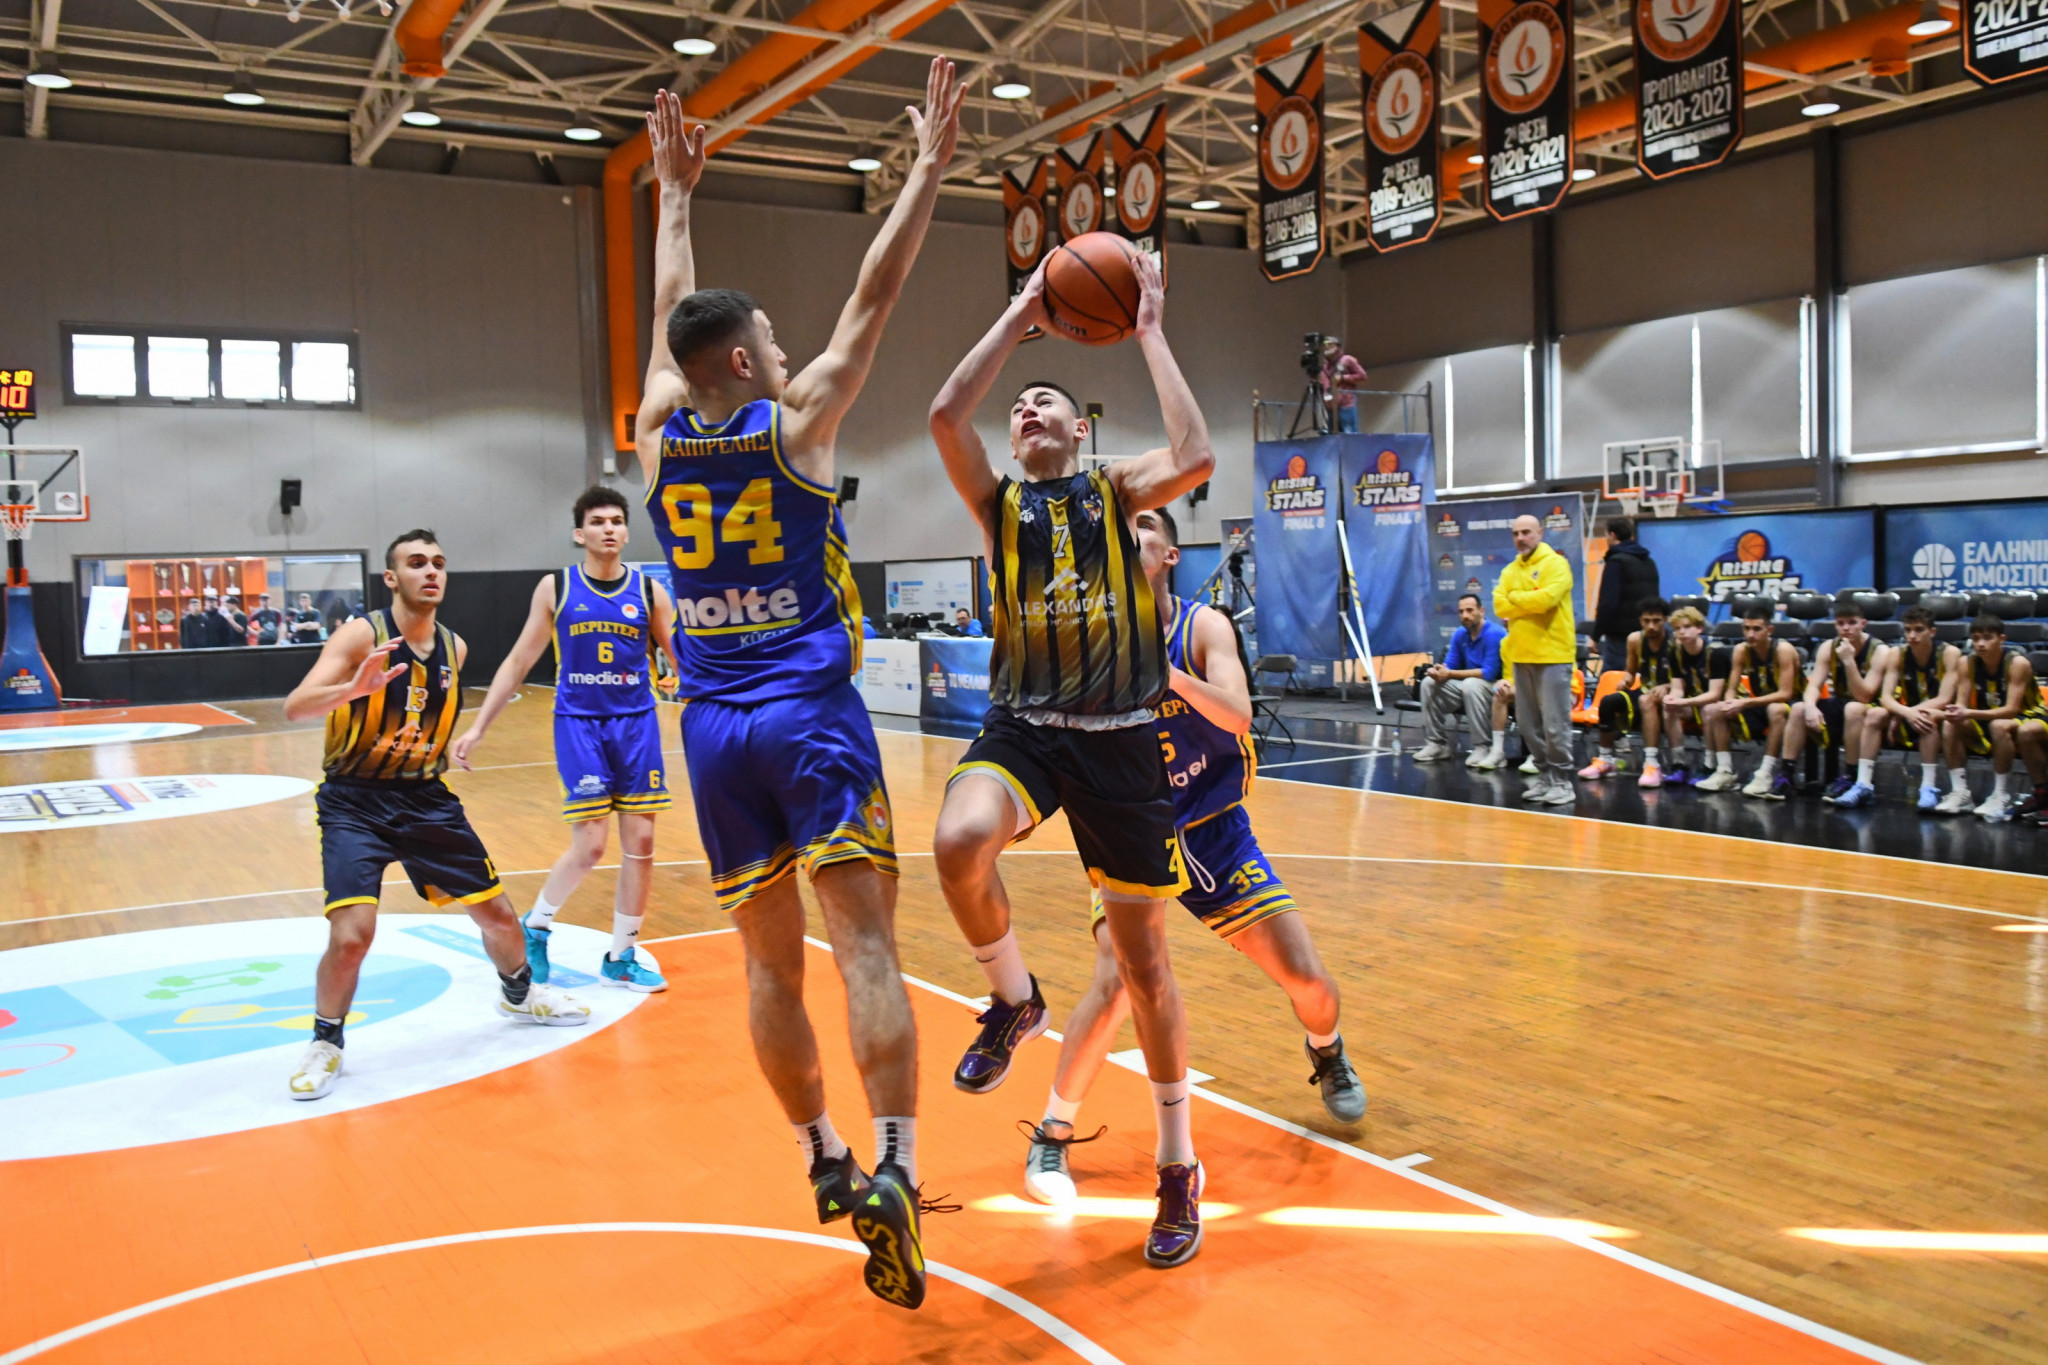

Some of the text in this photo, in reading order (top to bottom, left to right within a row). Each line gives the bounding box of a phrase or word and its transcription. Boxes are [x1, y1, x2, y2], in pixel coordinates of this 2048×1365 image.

[1643, 83, 1732, 136] 2020-2021
[1490, 134, 1566, 181] 2020-2021
[1277, 475, 1316, 491] RISING
[1367, 471, 1411, 485] RISING
[1272, 489, 1324, 511] STARS
[1362, 485, 1421, 506] STARS
[661, 477, 785, 570] 94
[1052, 523, 1070, 559] 7
[1721, 558, 1785, 576] RISING
[1711, 577, 1800, 602] STARS
[676, 586, 800, 628] nolte
[598, 641, 614, 664] 6
[568, 670, 640, 686] mediatel
[404, 685, 429, 713] 13
[648, 769, 661, 789] 6
[1228, 859, 1269, 894] 35
